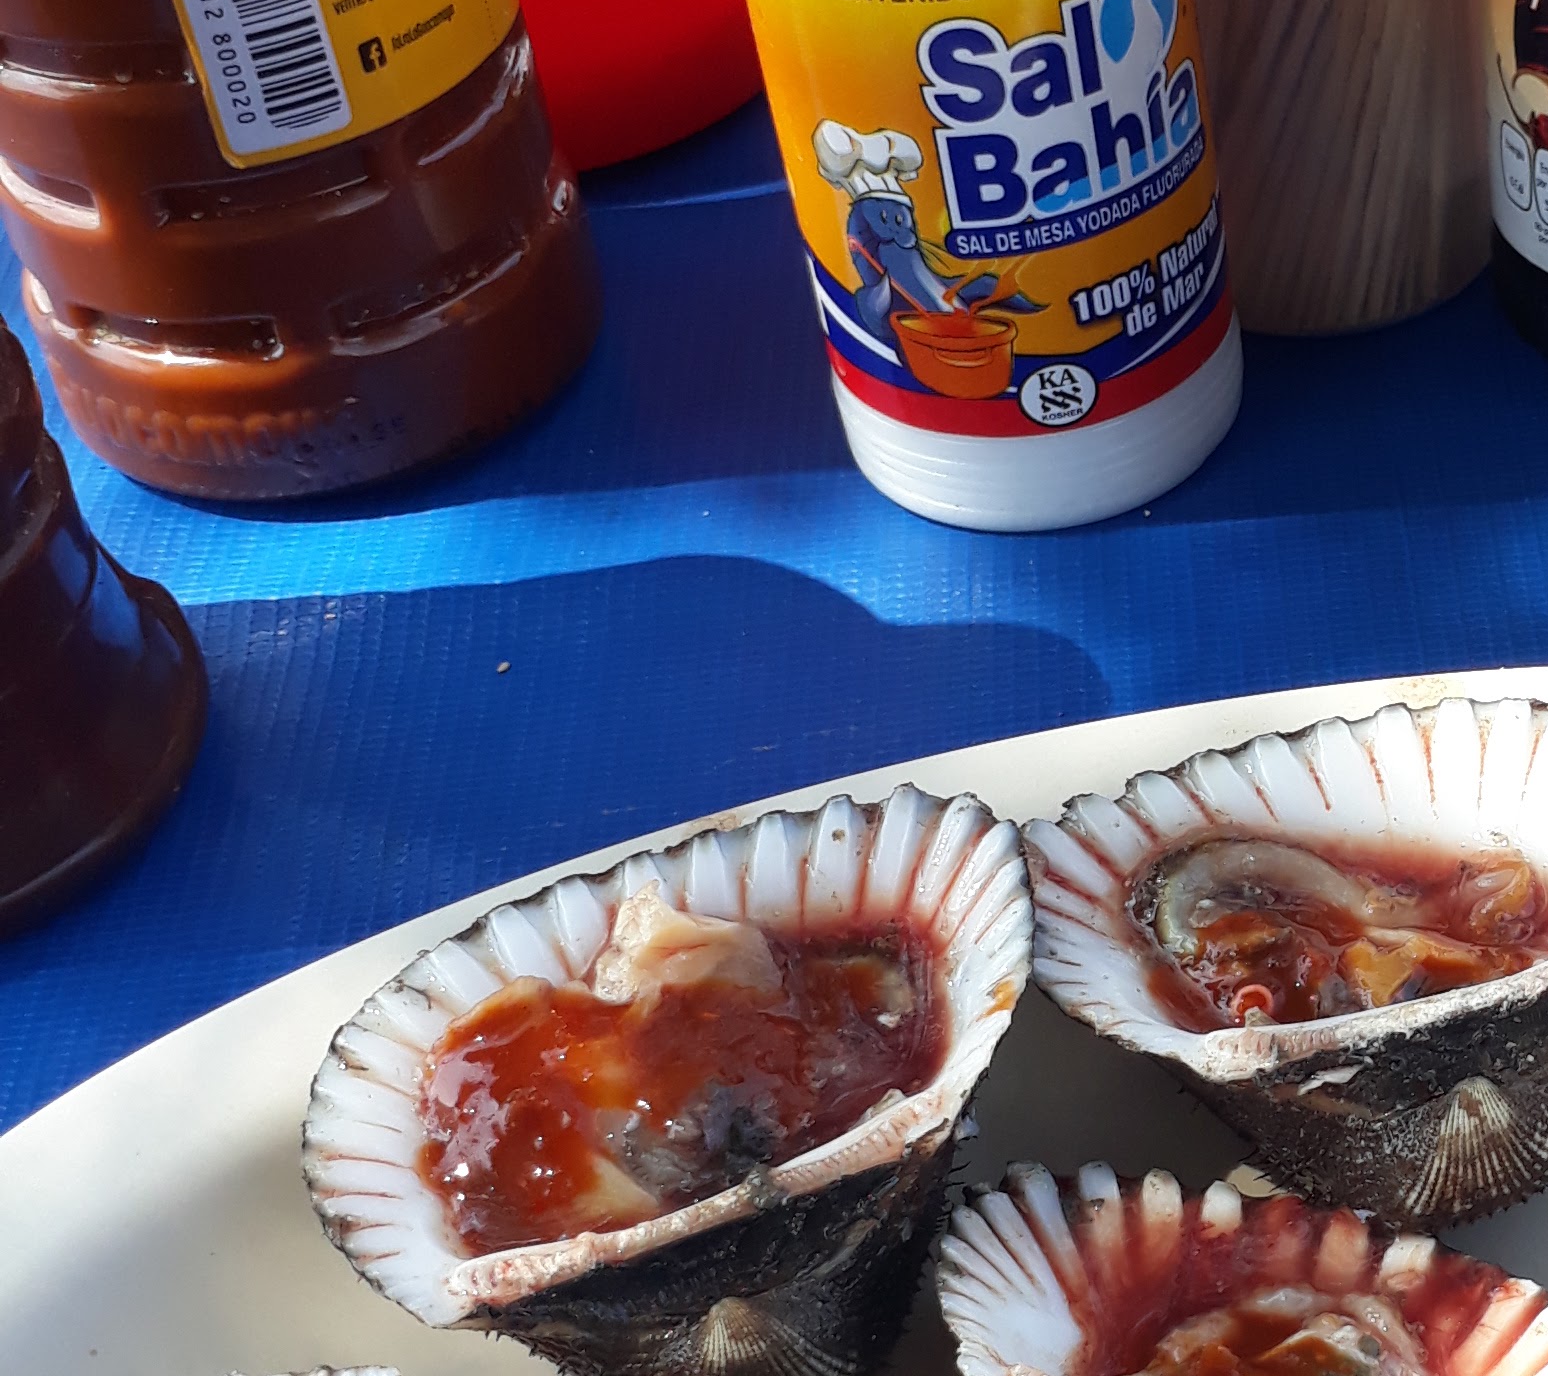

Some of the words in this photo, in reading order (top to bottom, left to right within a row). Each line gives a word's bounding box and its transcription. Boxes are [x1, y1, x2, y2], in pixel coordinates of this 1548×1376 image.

[212, 33, 257, 124] 800020
[928, 1, 1101, 124] Sal
[946, 60, 1198, 223] Bahía
[956, 235, 992, 255] SAL
[996, 230, 1022, 251] DE
[1025, 223, 1074, 249] MESA
[1077, 194, 1140, 234] YODADA
[1072, 262, 1155, 324] 100%
[1124, 303, 1158, 337] de
[1161, 262, 1206, 316] Mar
[1038, 367, 1079, 391] KA
[1041, 407, 1083, 421] KOSHER
